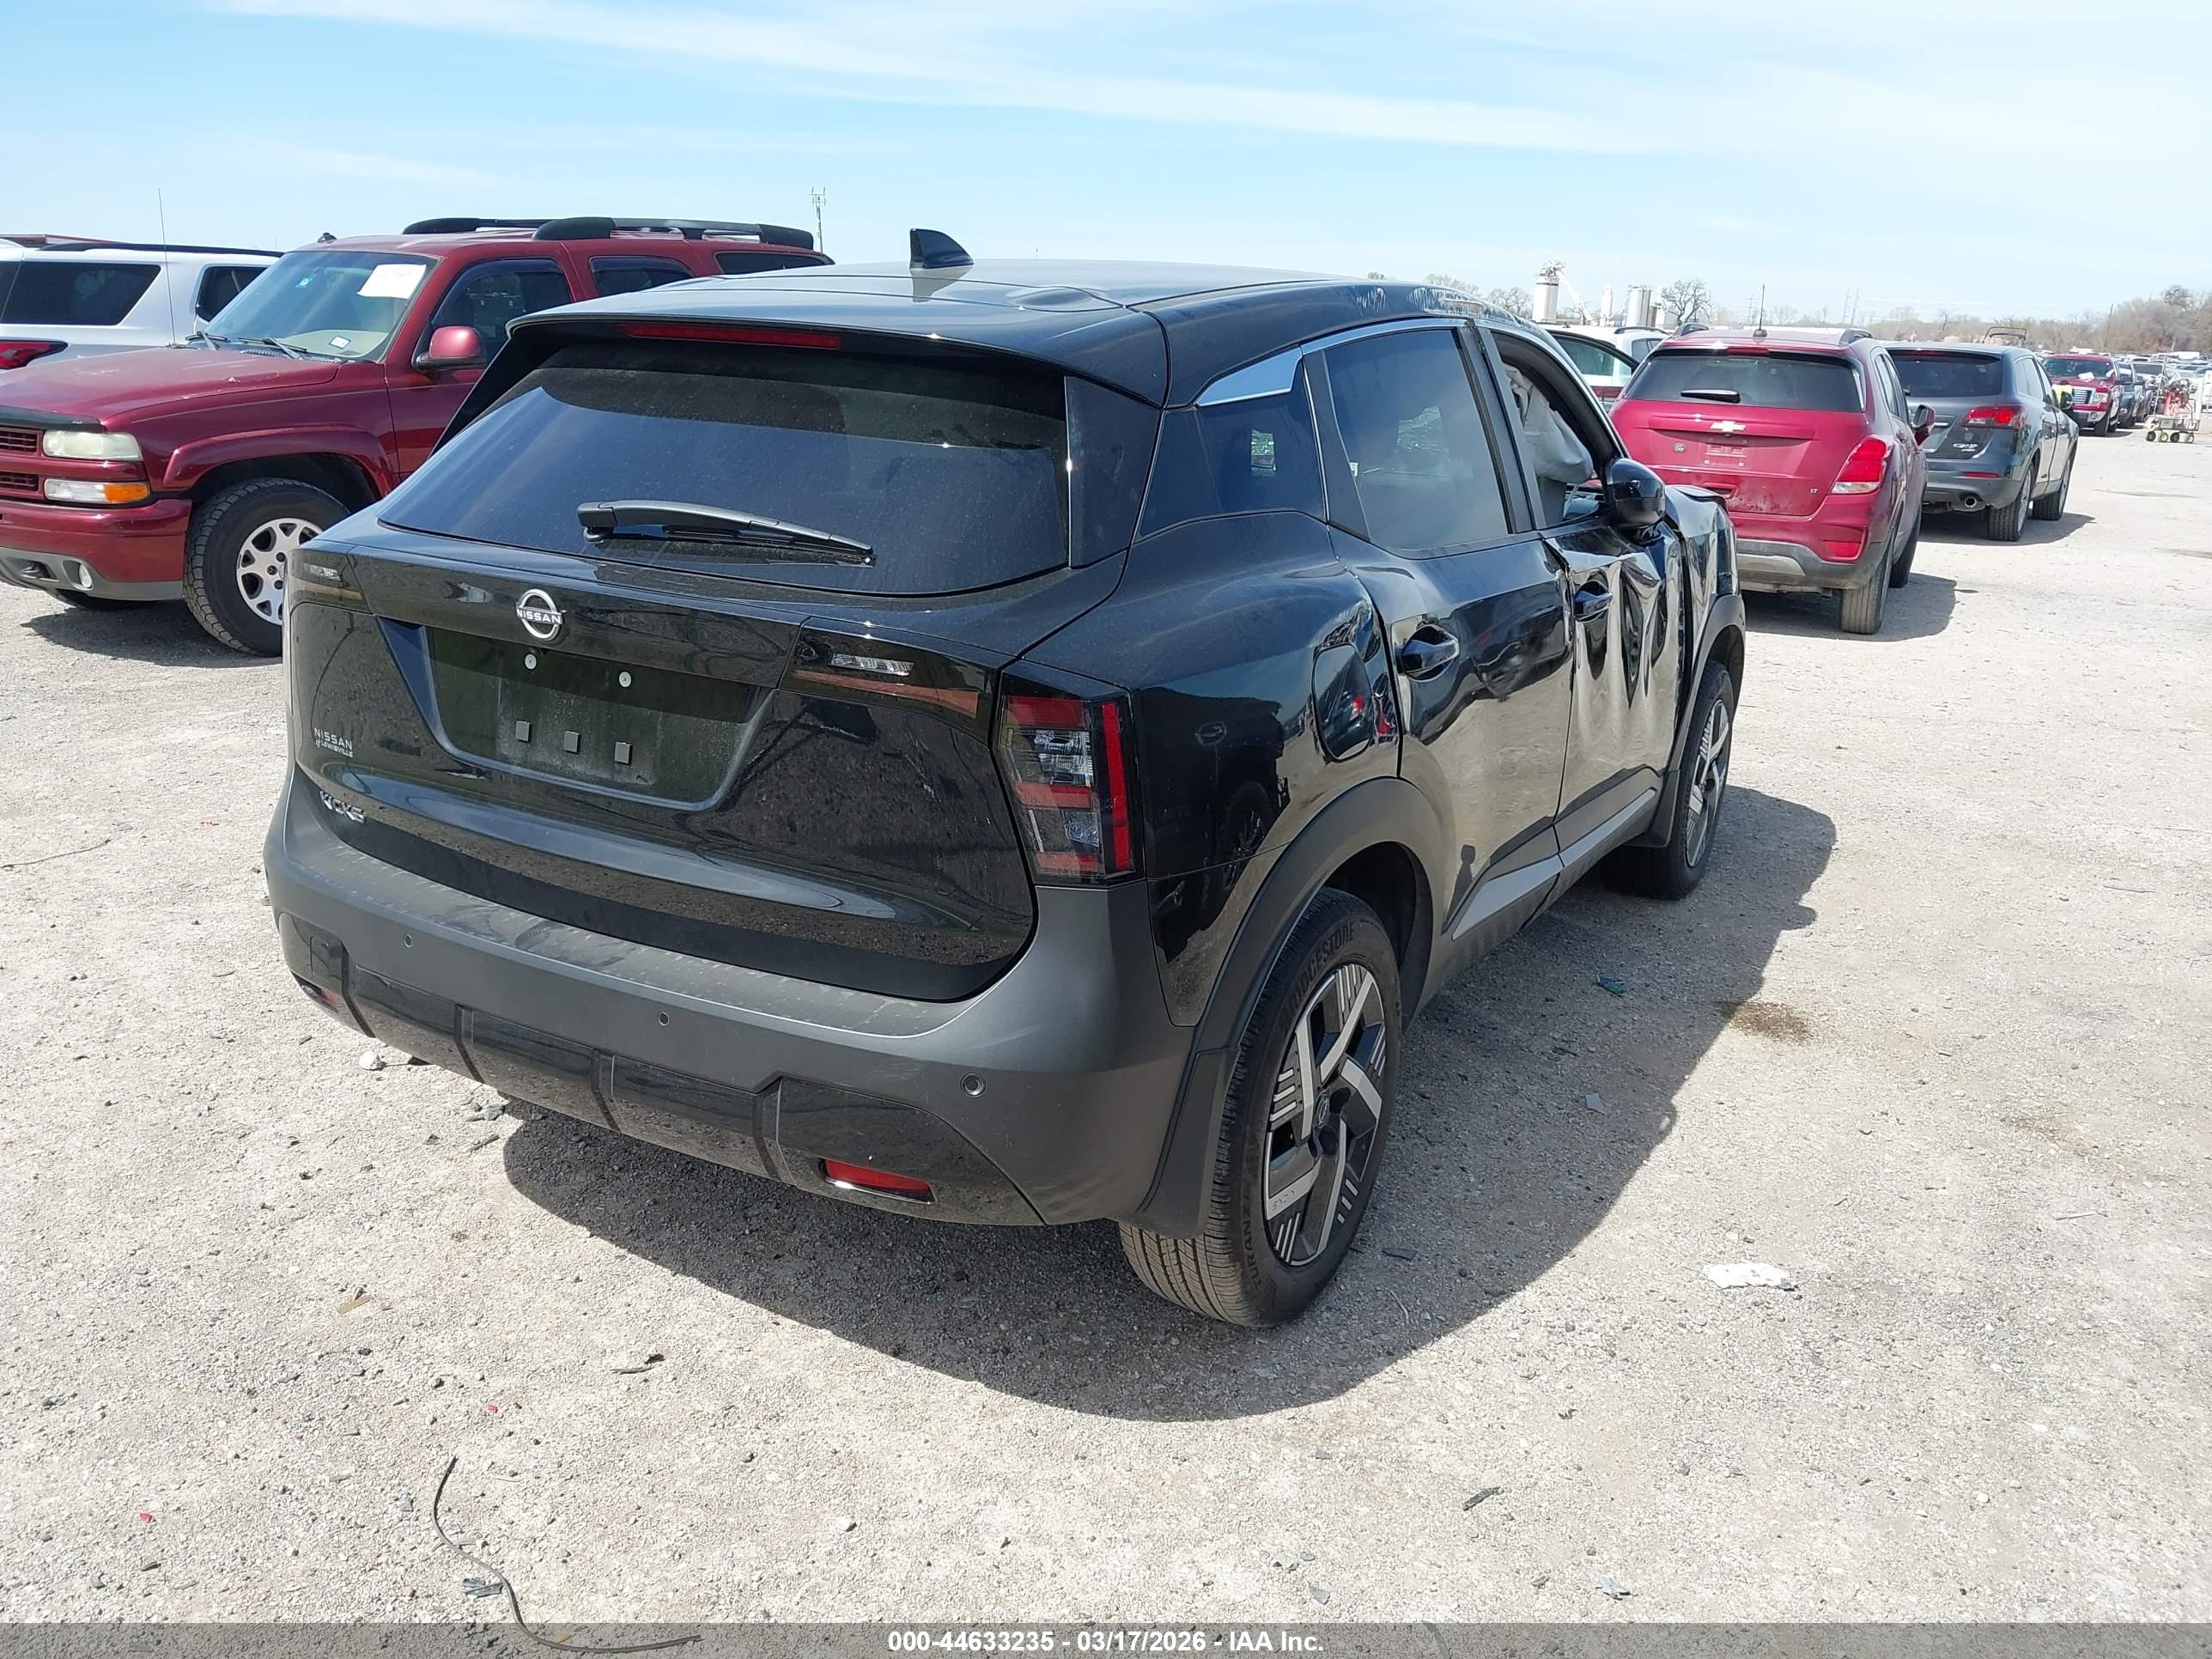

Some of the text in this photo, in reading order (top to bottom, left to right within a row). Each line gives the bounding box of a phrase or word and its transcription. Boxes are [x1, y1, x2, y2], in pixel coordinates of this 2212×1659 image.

[516, 608, 561, 624] NISSAN
[314, 727, 353, 750] NISSAN
[321, 740, 353, 758] LEWISVILLE
